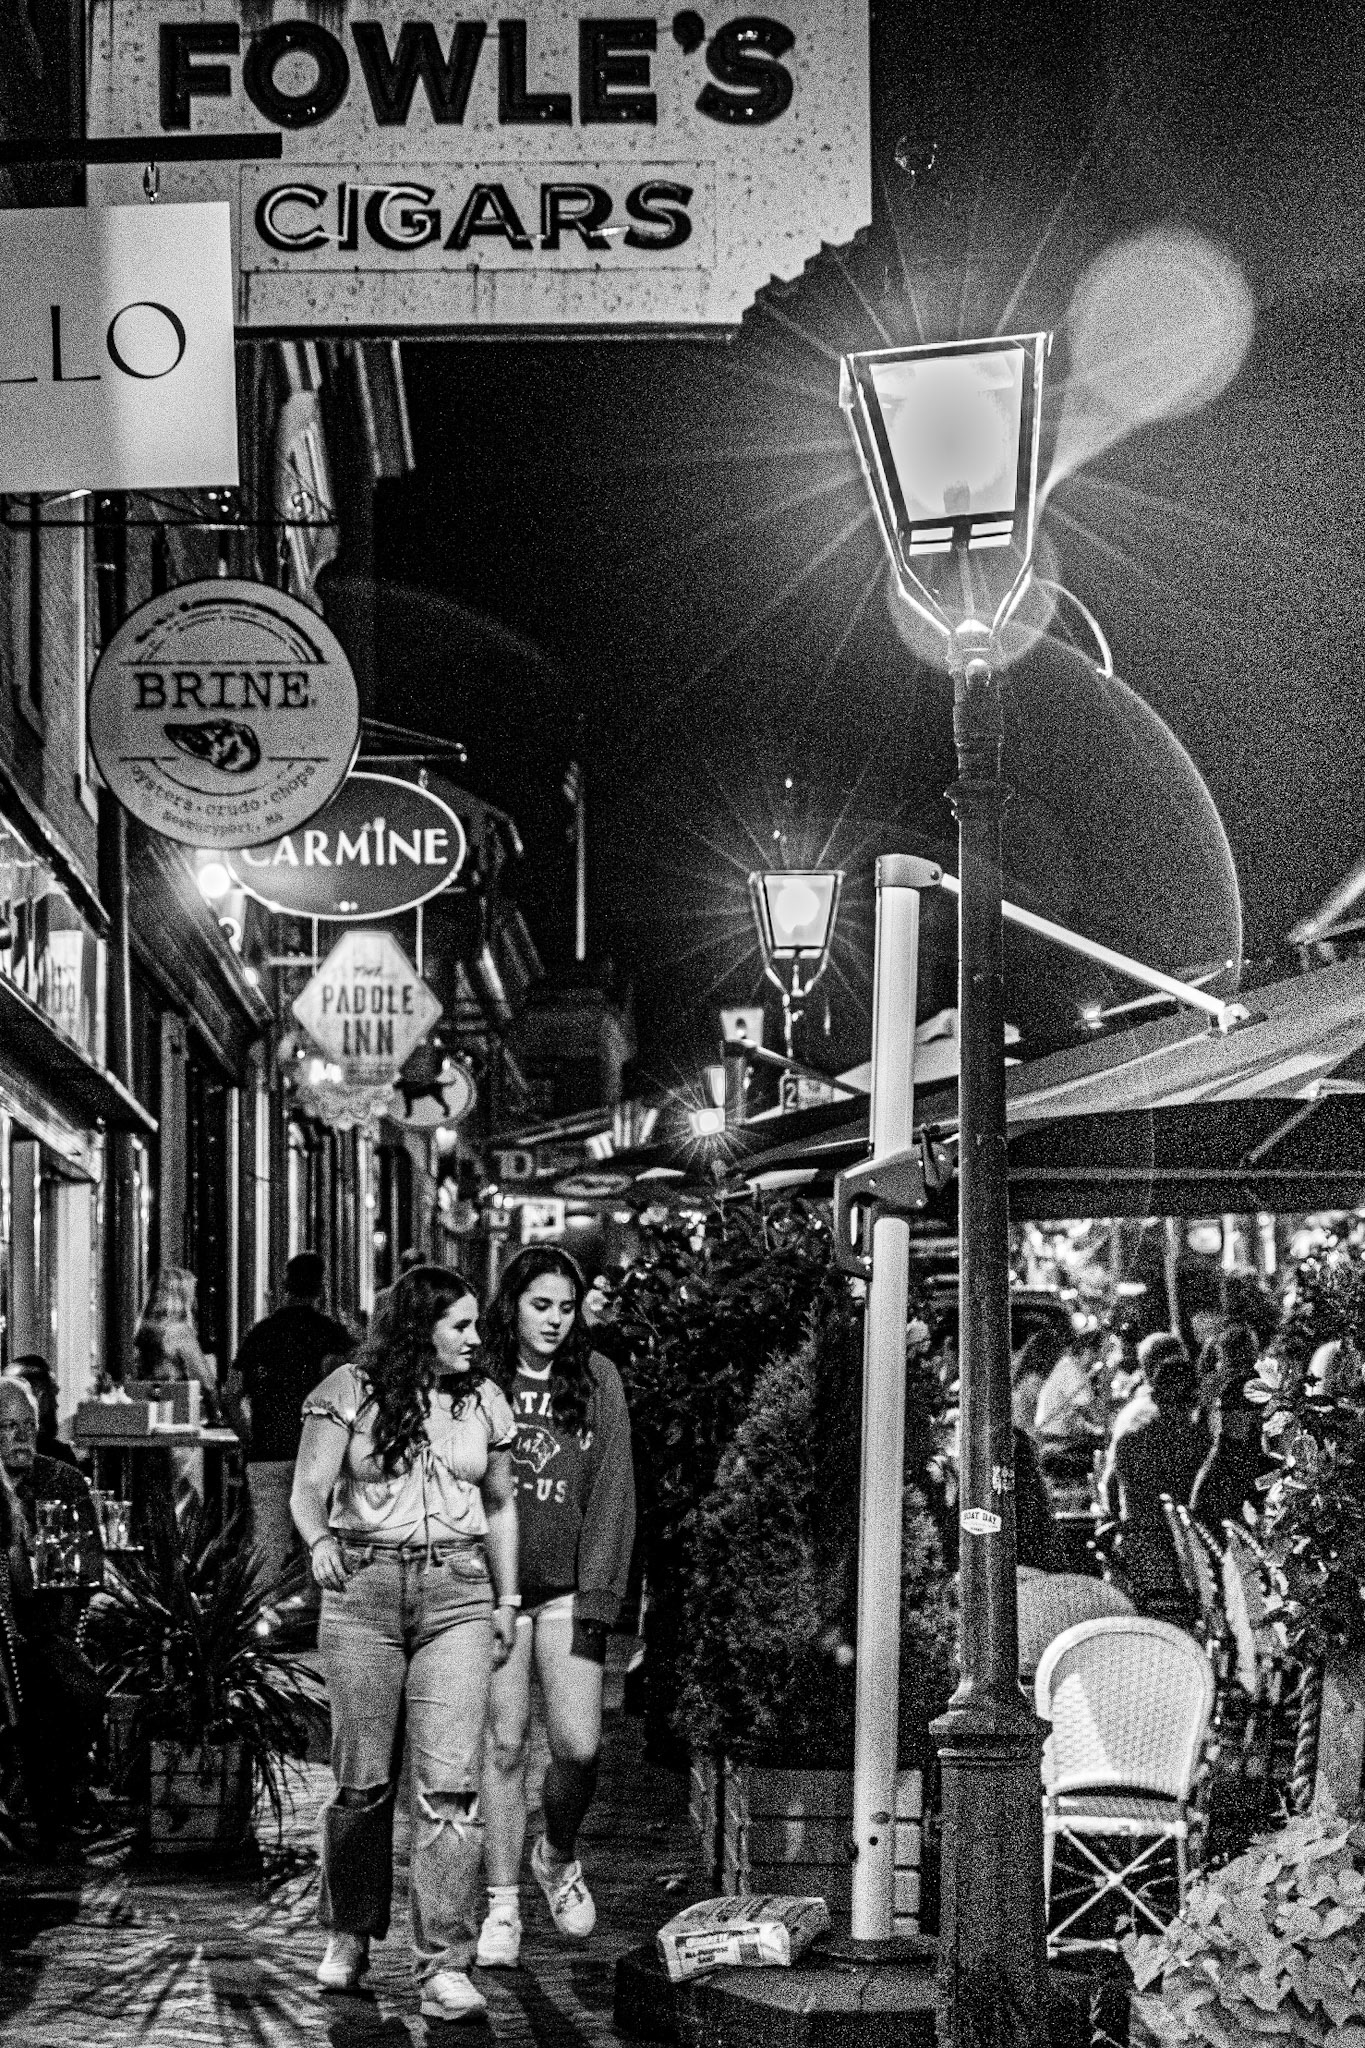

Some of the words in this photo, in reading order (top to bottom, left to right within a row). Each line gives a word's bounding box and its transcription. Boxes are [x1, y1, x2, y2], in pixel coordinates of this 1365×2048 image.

[159, 10, 796, 130] FOWLE'S
[254, 181, 694, 252] CIGARS
[0, 302, 187, 382] LO
[134, 671, 309, 709] BRINE
[322, 984, 414, 1015] PADDLE
[342, 1019, 394, 1056] INN
